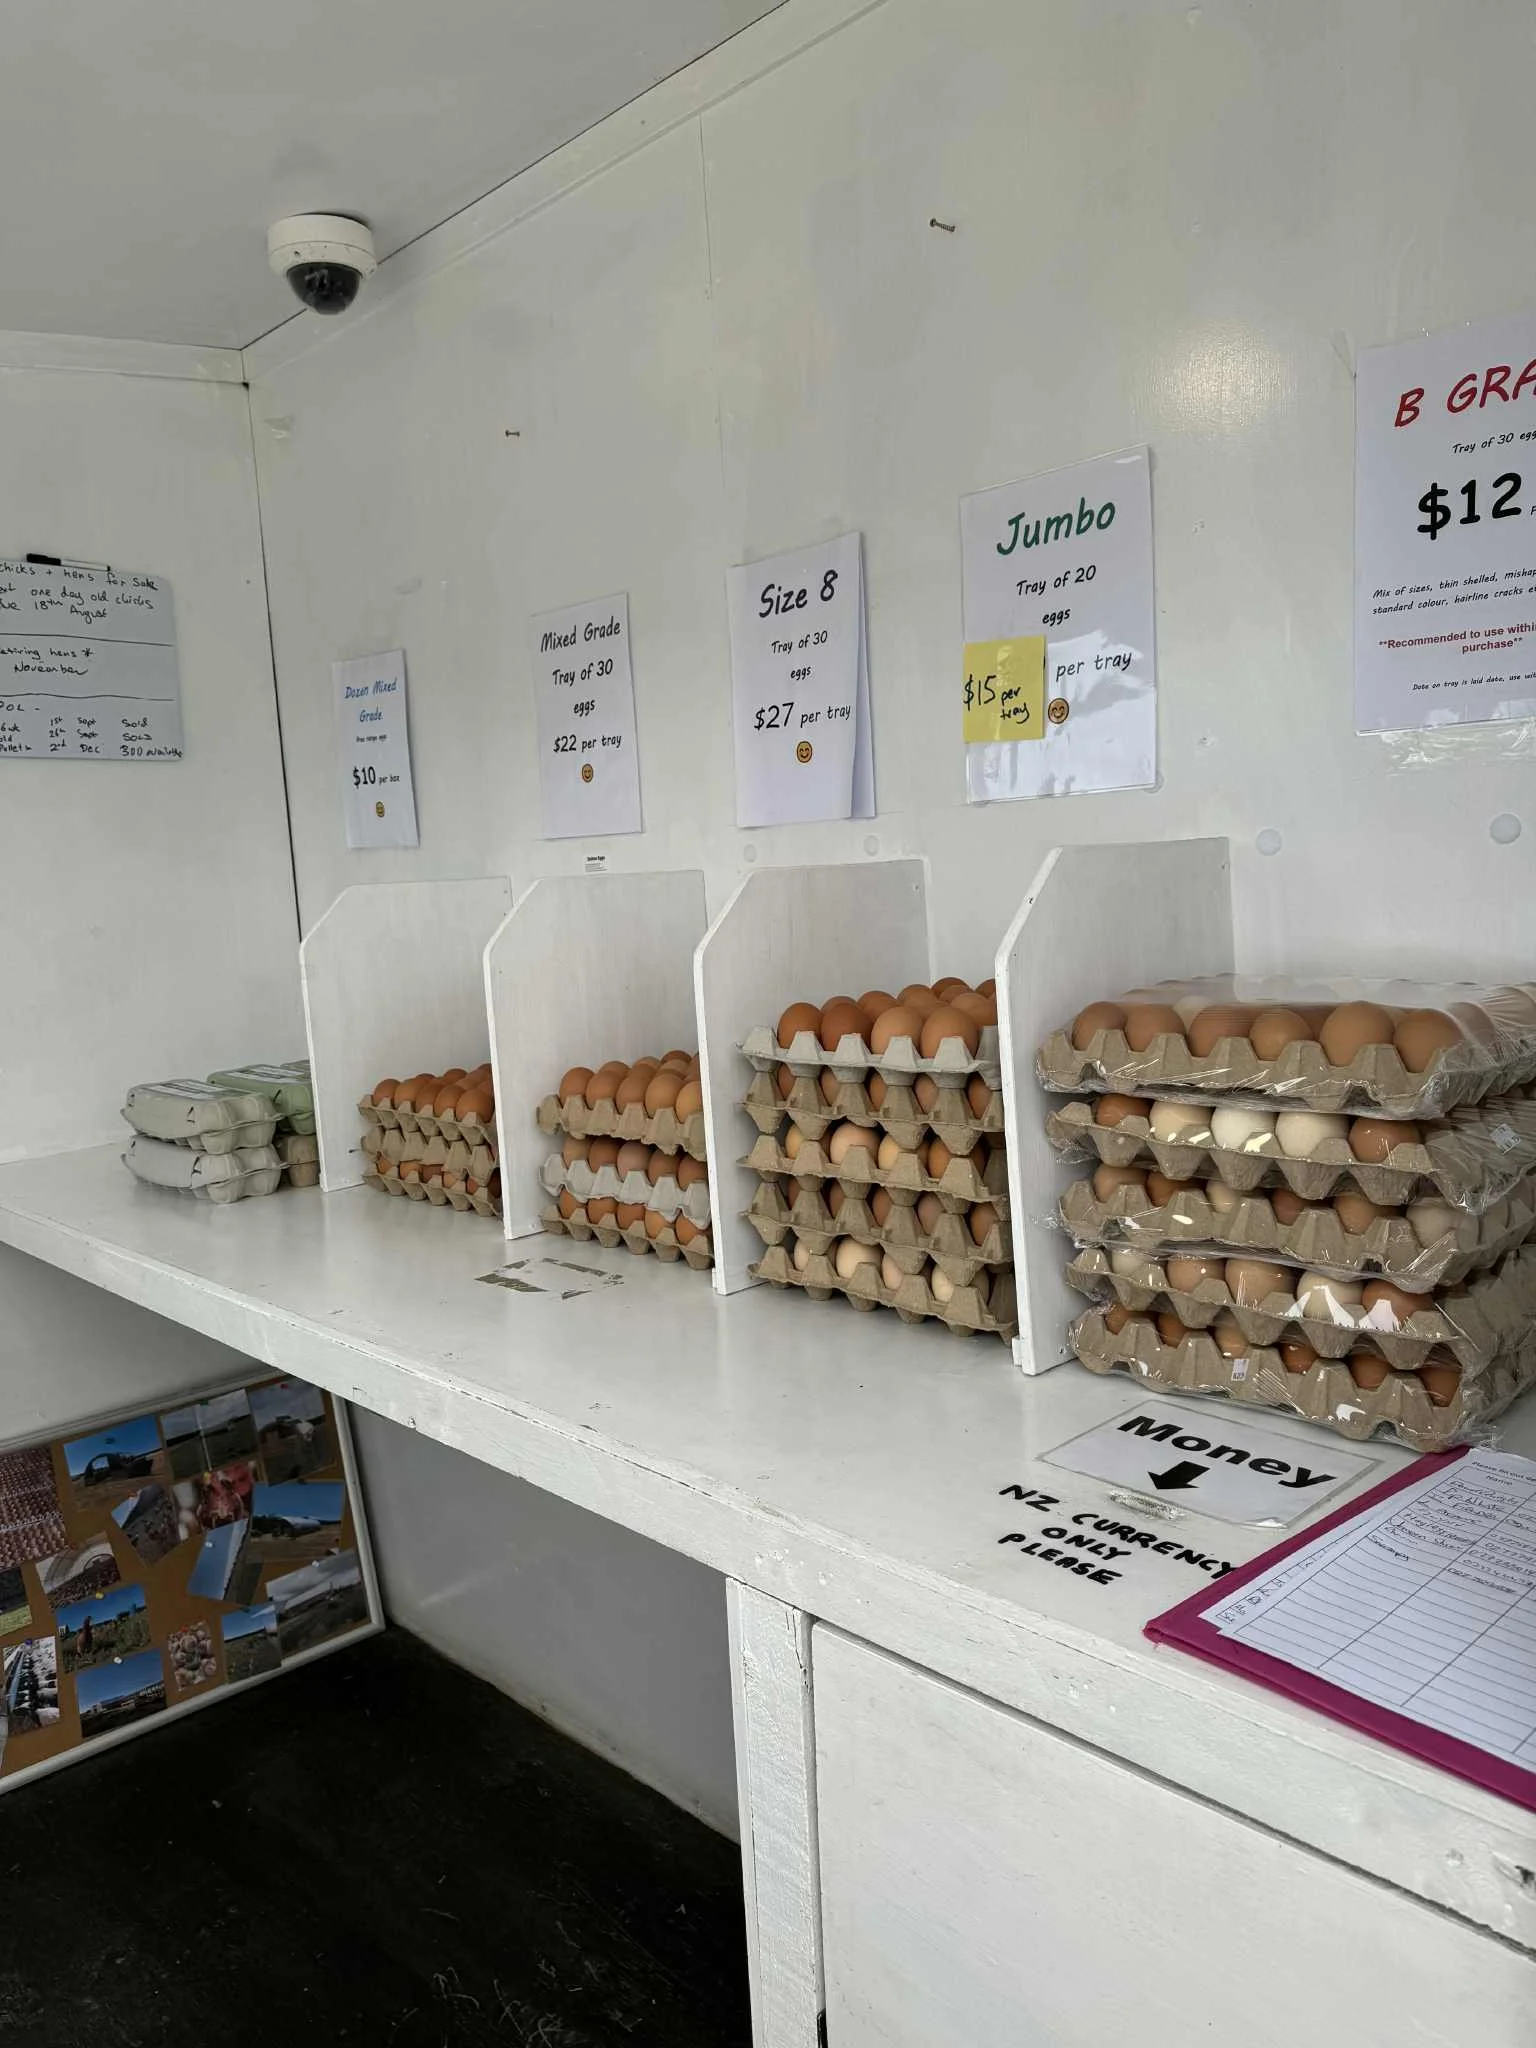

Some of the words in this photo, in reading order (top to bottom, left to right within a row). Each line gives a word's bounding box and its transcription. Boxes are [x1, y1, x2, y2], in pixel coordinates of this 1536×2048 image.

[1394, 387, 1425, 428] B
[1452, 443, 1476, 454] Tray
[1481, 437, 1496, 449] of
[1497, 432, 1514, 445] 30
[1417, 472, 1522, 541] $12
[996, 497, 1116, 556] Jumbo
[64, 569, 95, 582] hens
[1016, 580, 1047, 597] Tray
[1053, 571, 1071, 590] of
[1075, 564, 1097, 584] 20
[1372, 589, 1391, 599] Mix
[1394, 585, 1407, 597] of
[1408, 584, 1433, 594] sizes,
[1439, 579, 1459, 590] thin
[1463, 571, 1498, 586] shelled,
[61, 586, 84, 606] day
[90, 590, 108, 602] old
[758, 584, 808, 618] Size
[820, 569, 839, 602] 8
[1372, 600, 1415, 615] standard
[1417, 598, 1449, 609] colour,
[1454, 591, 1490, 604] hairline
[1493, 586, 1523, 598] cracks
[70, 604, 108, 625] August
[1042, 607, 1071, 628] eggs
[540, 624, 577, 653] Mixed
[583, 615, 621, 642] Grade
[771, 639, 793, 654] Tray
[798, 634, 810, 649] of
[812, 630, 828, 645] 30
[1470, 630, 1481, 639] to
[1484, 627, 1505, 638] use
[552, 668, 576, 687] Tray
[580, 662, 594, 680] of
[596, 658, 614, 677] 30
[790, 666, 812, 681] eggs
[1056, 658, 1086, 682] per
[1094, 651, 1133, 672] tray
[344, 685, 370, 700] Dozen
[372, 676, 398, 696] Mixed
[963, 673, 997, 713] $15
[1001, 686, 1022, 707] per
[1444, 680, 1459, 688] tray
[1470, 676, 1484, 685] laid
[359, 703, 384, 723] Grade
[573, 699, 595, 718] eggs
[754, 702, 795, 731] $27
[800, 710, 820, 729] per
[827, 705, 851, 721] tray
[999, 702, 1030, 725] tray
[553, 734, 577, 753] $22
[581, 738, 597, 753] per
[601, 735, 622, 749] tray
[352, 765, 376, 789] $10
[379, 776, 388, 786] per
[389, 773, 401, 783] box
[1117, 1415, 1338, 1490] Money
[998, 1484, 1061, 1514] NZ
[1071, 1512, 1238, 1580] CURRENCY
[1041, 1526, 1132, 1561] ONLY
[998, 1532, 1124, 1586] PLEASE
